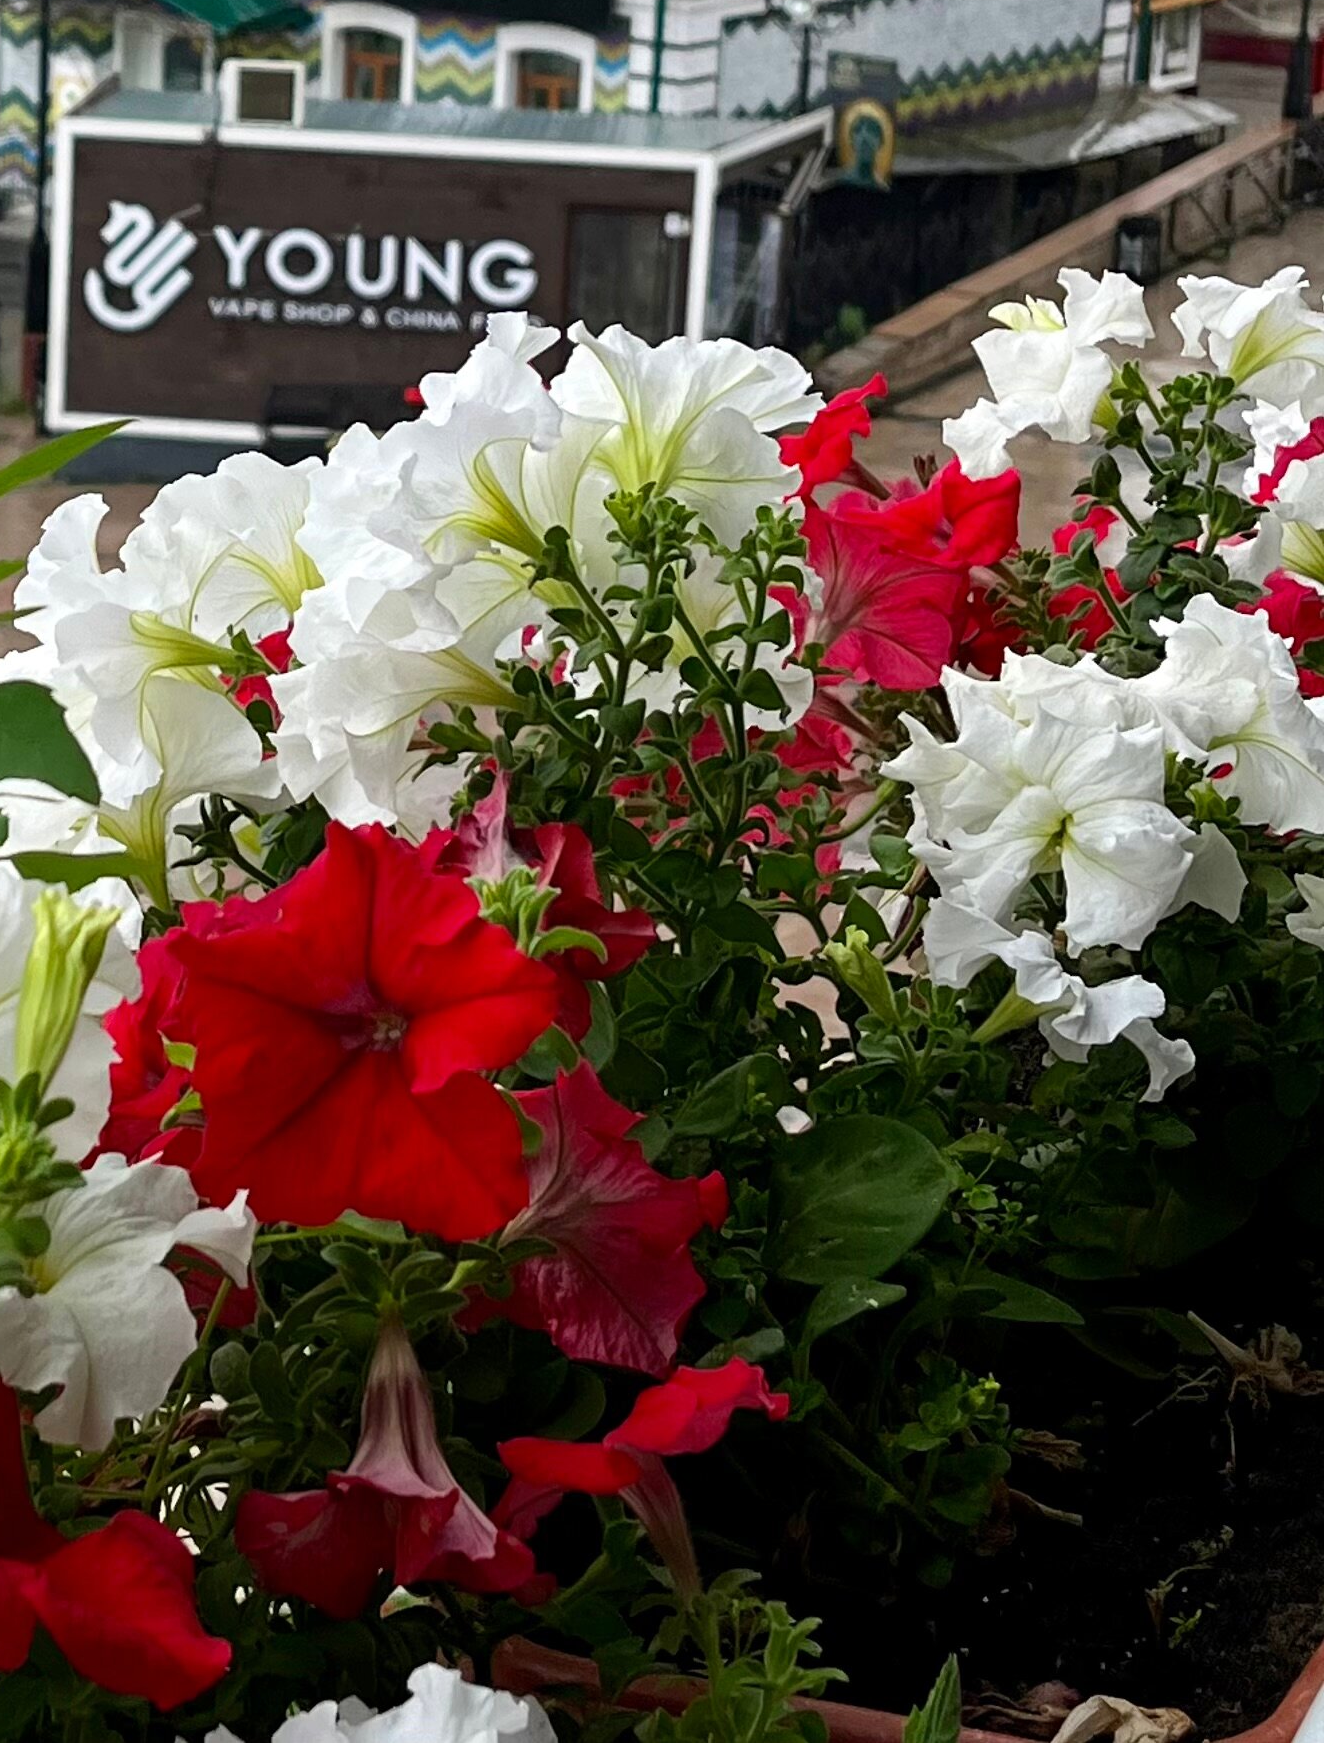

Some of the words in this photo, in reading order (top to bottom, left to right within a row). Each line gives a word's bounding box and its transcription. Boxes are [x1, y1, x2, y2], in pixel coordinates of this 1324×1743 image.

[212, 224, 540, 308] YOUNG
[207, 297, 275, 322] VAPE
[281, 300, 357, 325] SHOP
[359, 305, 380, 329] &
[384, 306, 462, 332] CHINA
